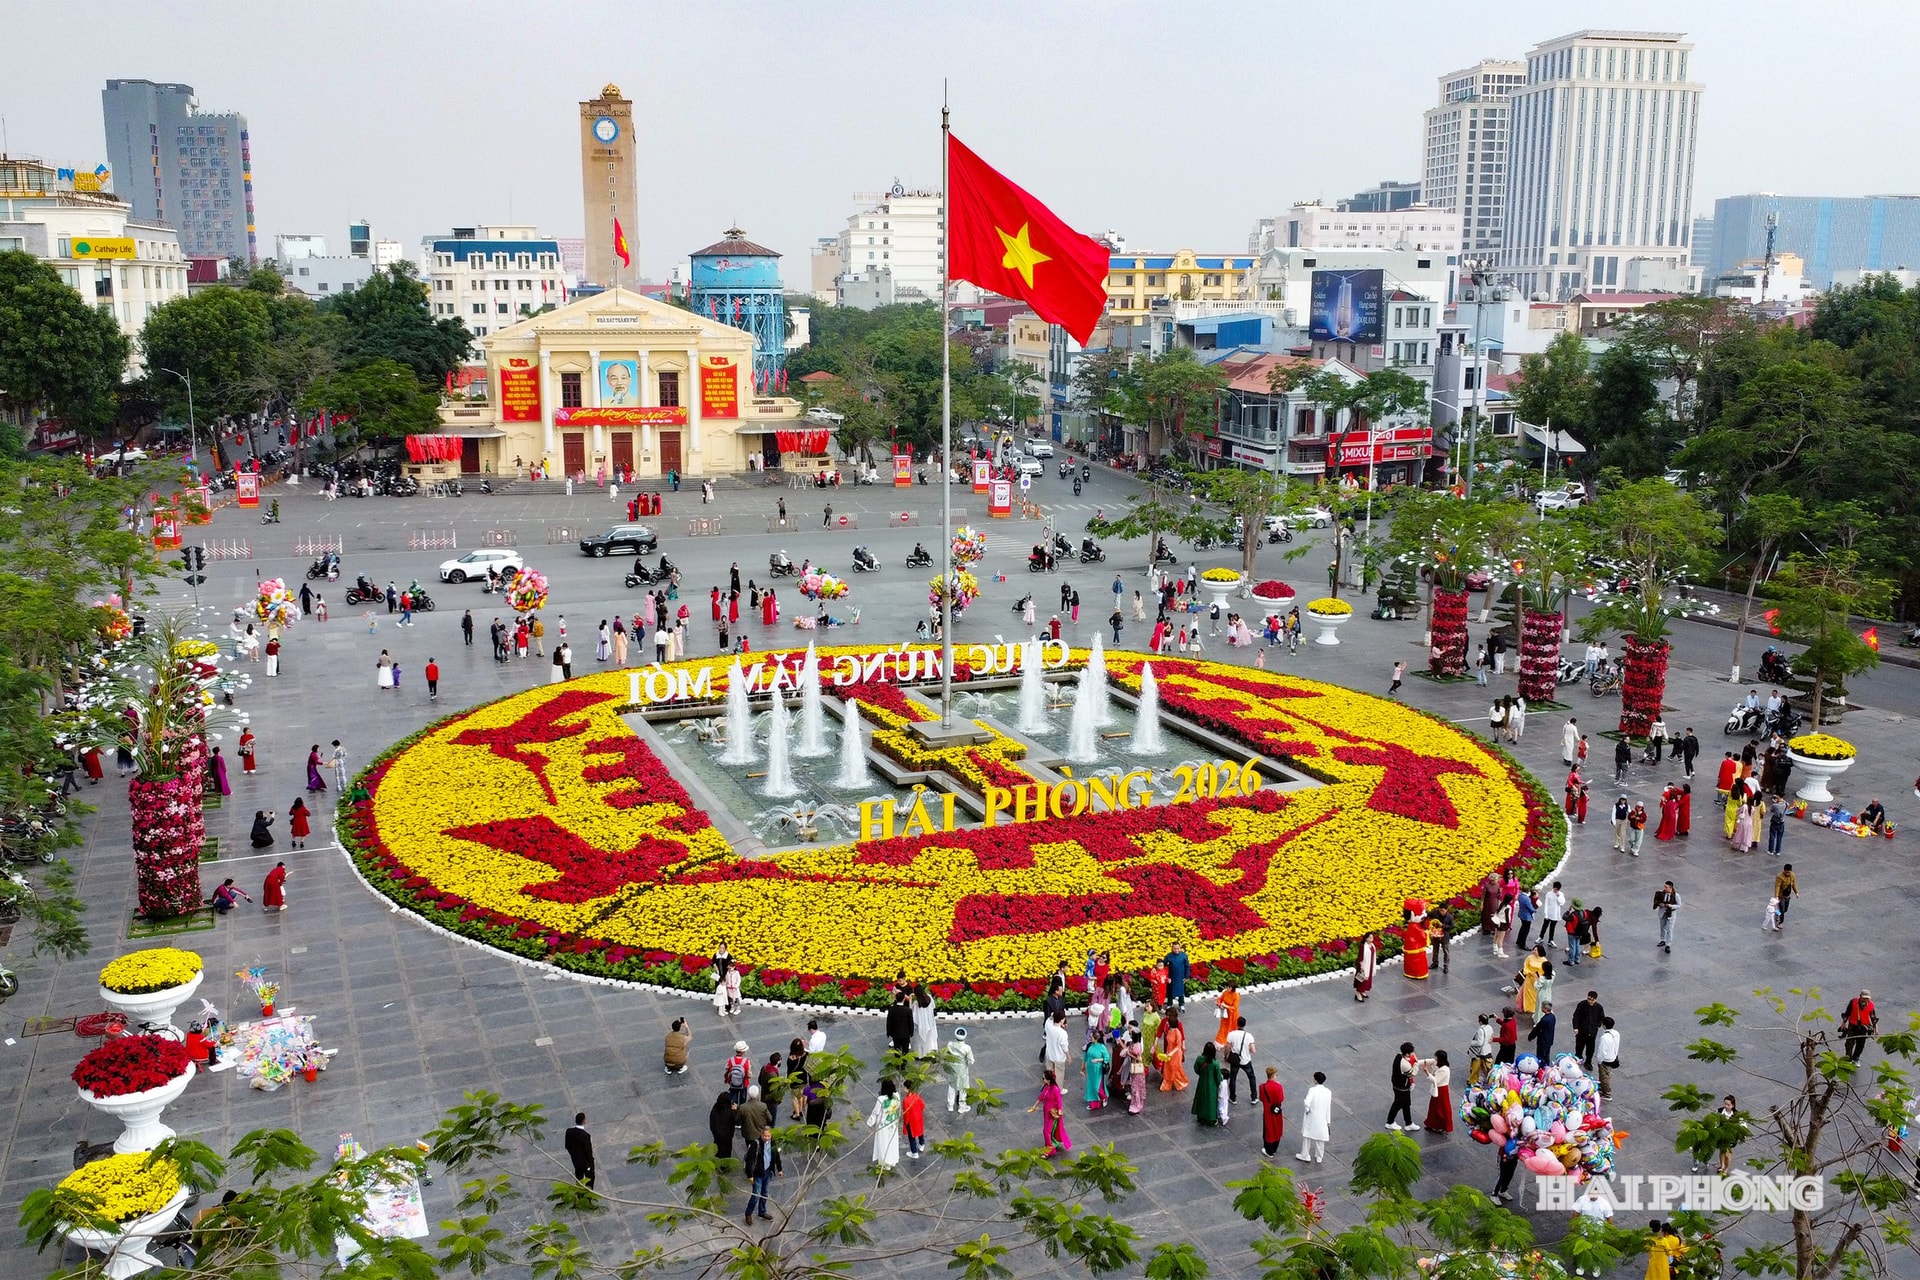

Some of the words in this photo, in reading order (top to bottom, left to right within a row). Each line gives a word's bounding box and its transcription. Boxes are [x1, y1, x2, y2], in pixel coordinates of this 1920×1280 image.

[74, 180, 102, 191] Bank
[94, 245, 118, 254] Cathay
[119, 245, 132, 253] Life
[1345, 446, 1373, 458] MIXUE
[856, 784, 958, 843] HẢI
[982, 765, 1154, 828] PHÒNG
[1171, 755, 1263, 805] 2026
